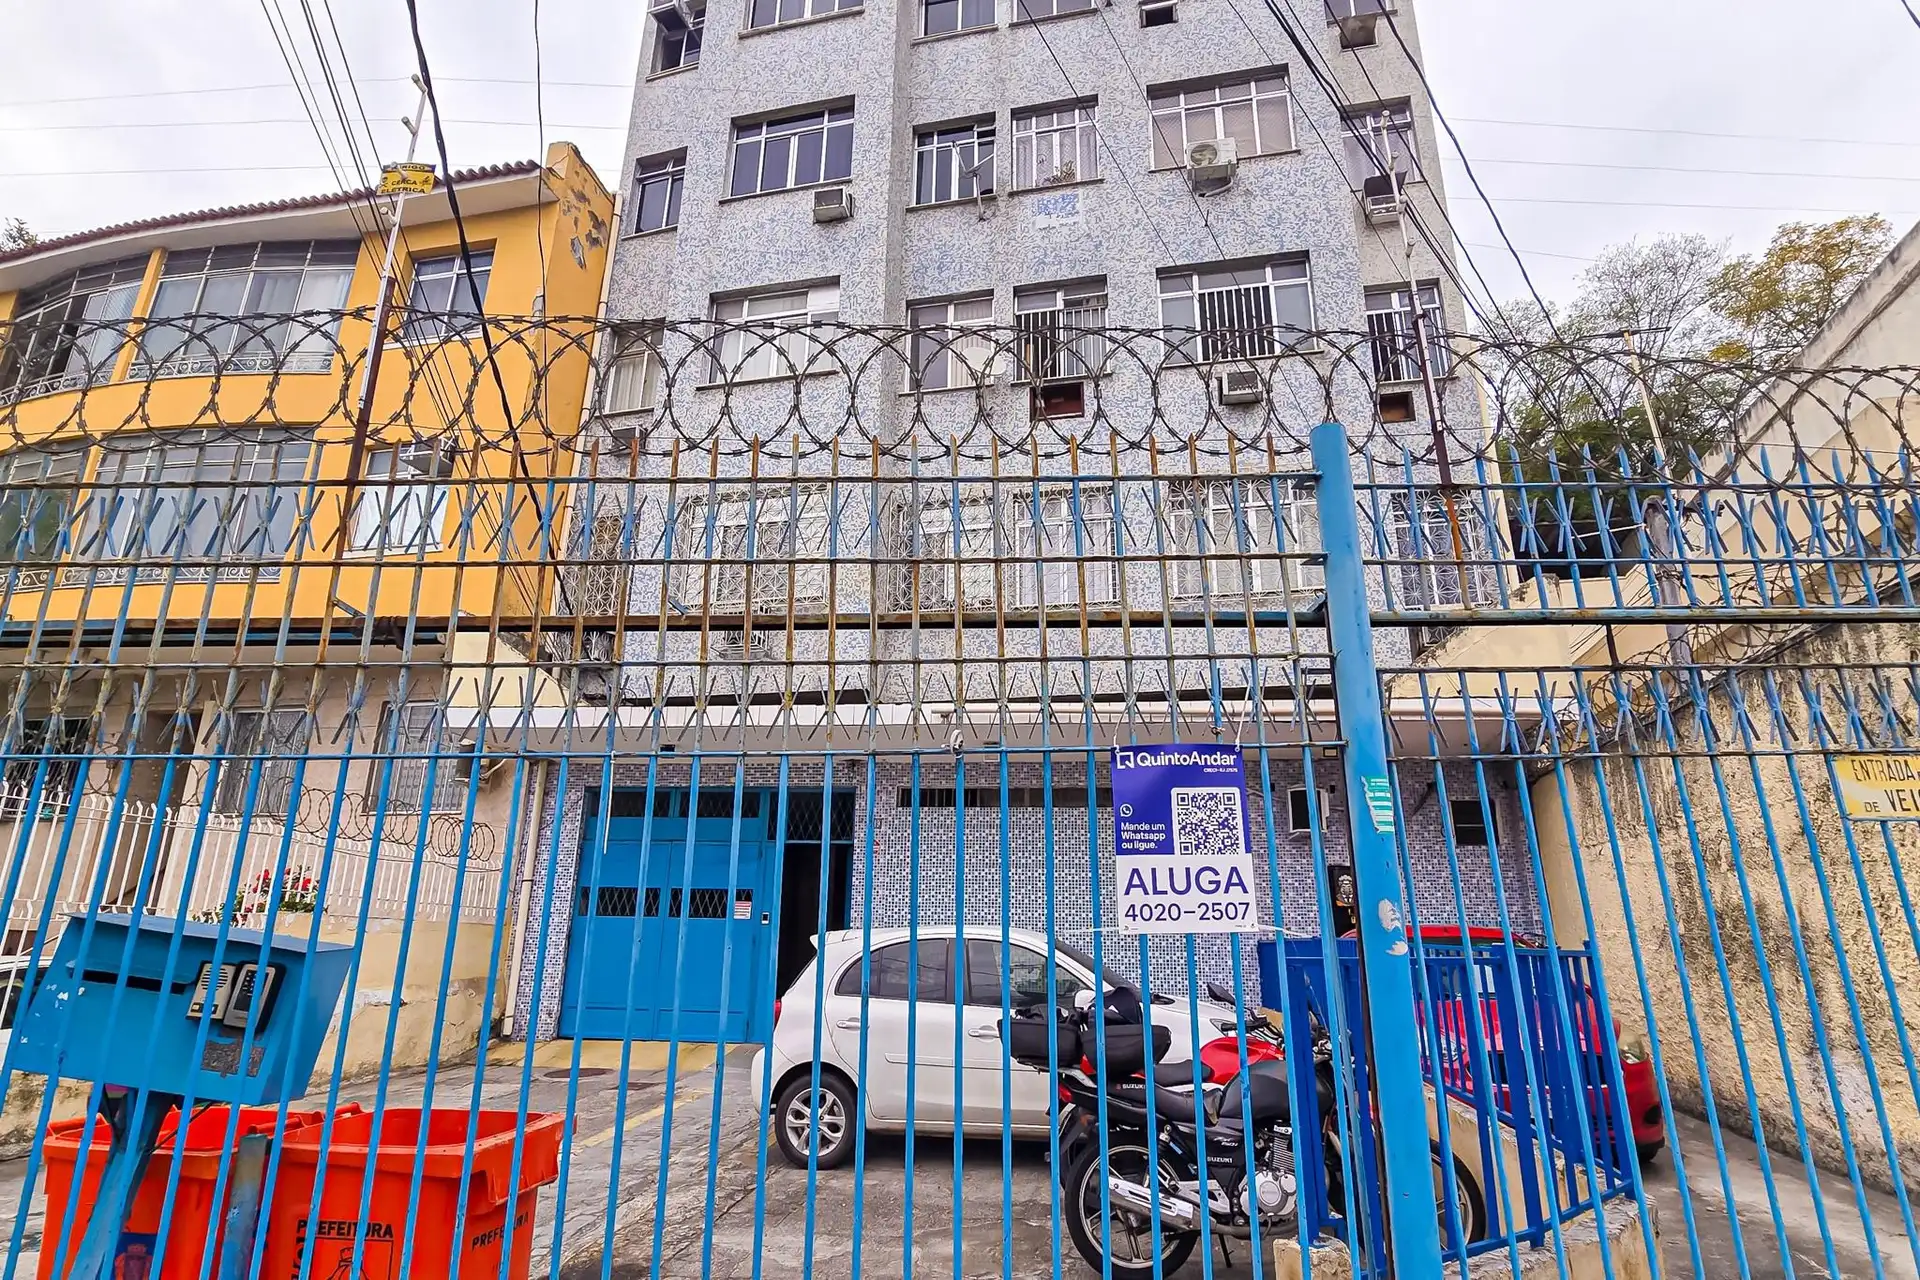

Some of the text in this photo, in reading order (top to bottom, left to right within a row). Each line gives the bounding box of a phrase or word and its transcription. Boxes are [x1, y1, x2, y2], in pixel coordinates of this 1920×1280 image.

[1137, 751, 1237, 767] QuintoAndar
[1851, 759, 1916, 782] ENTRADA
[1864, 789, 1920, 813] DE VEI
[1121, 822, 1165, 831] Mande um
[1121, 831, 1166, 841] Whatsapp
[1121, 840, 1158, 850] ou ligue.
[1124, 866, 1249, 896] ALUGA
[1125, 902, 1250, 922] 4020-2507
[296, 1219, 394, 1239] PEFEITRA
[472, 1211, 529, 1251] PREFERA
